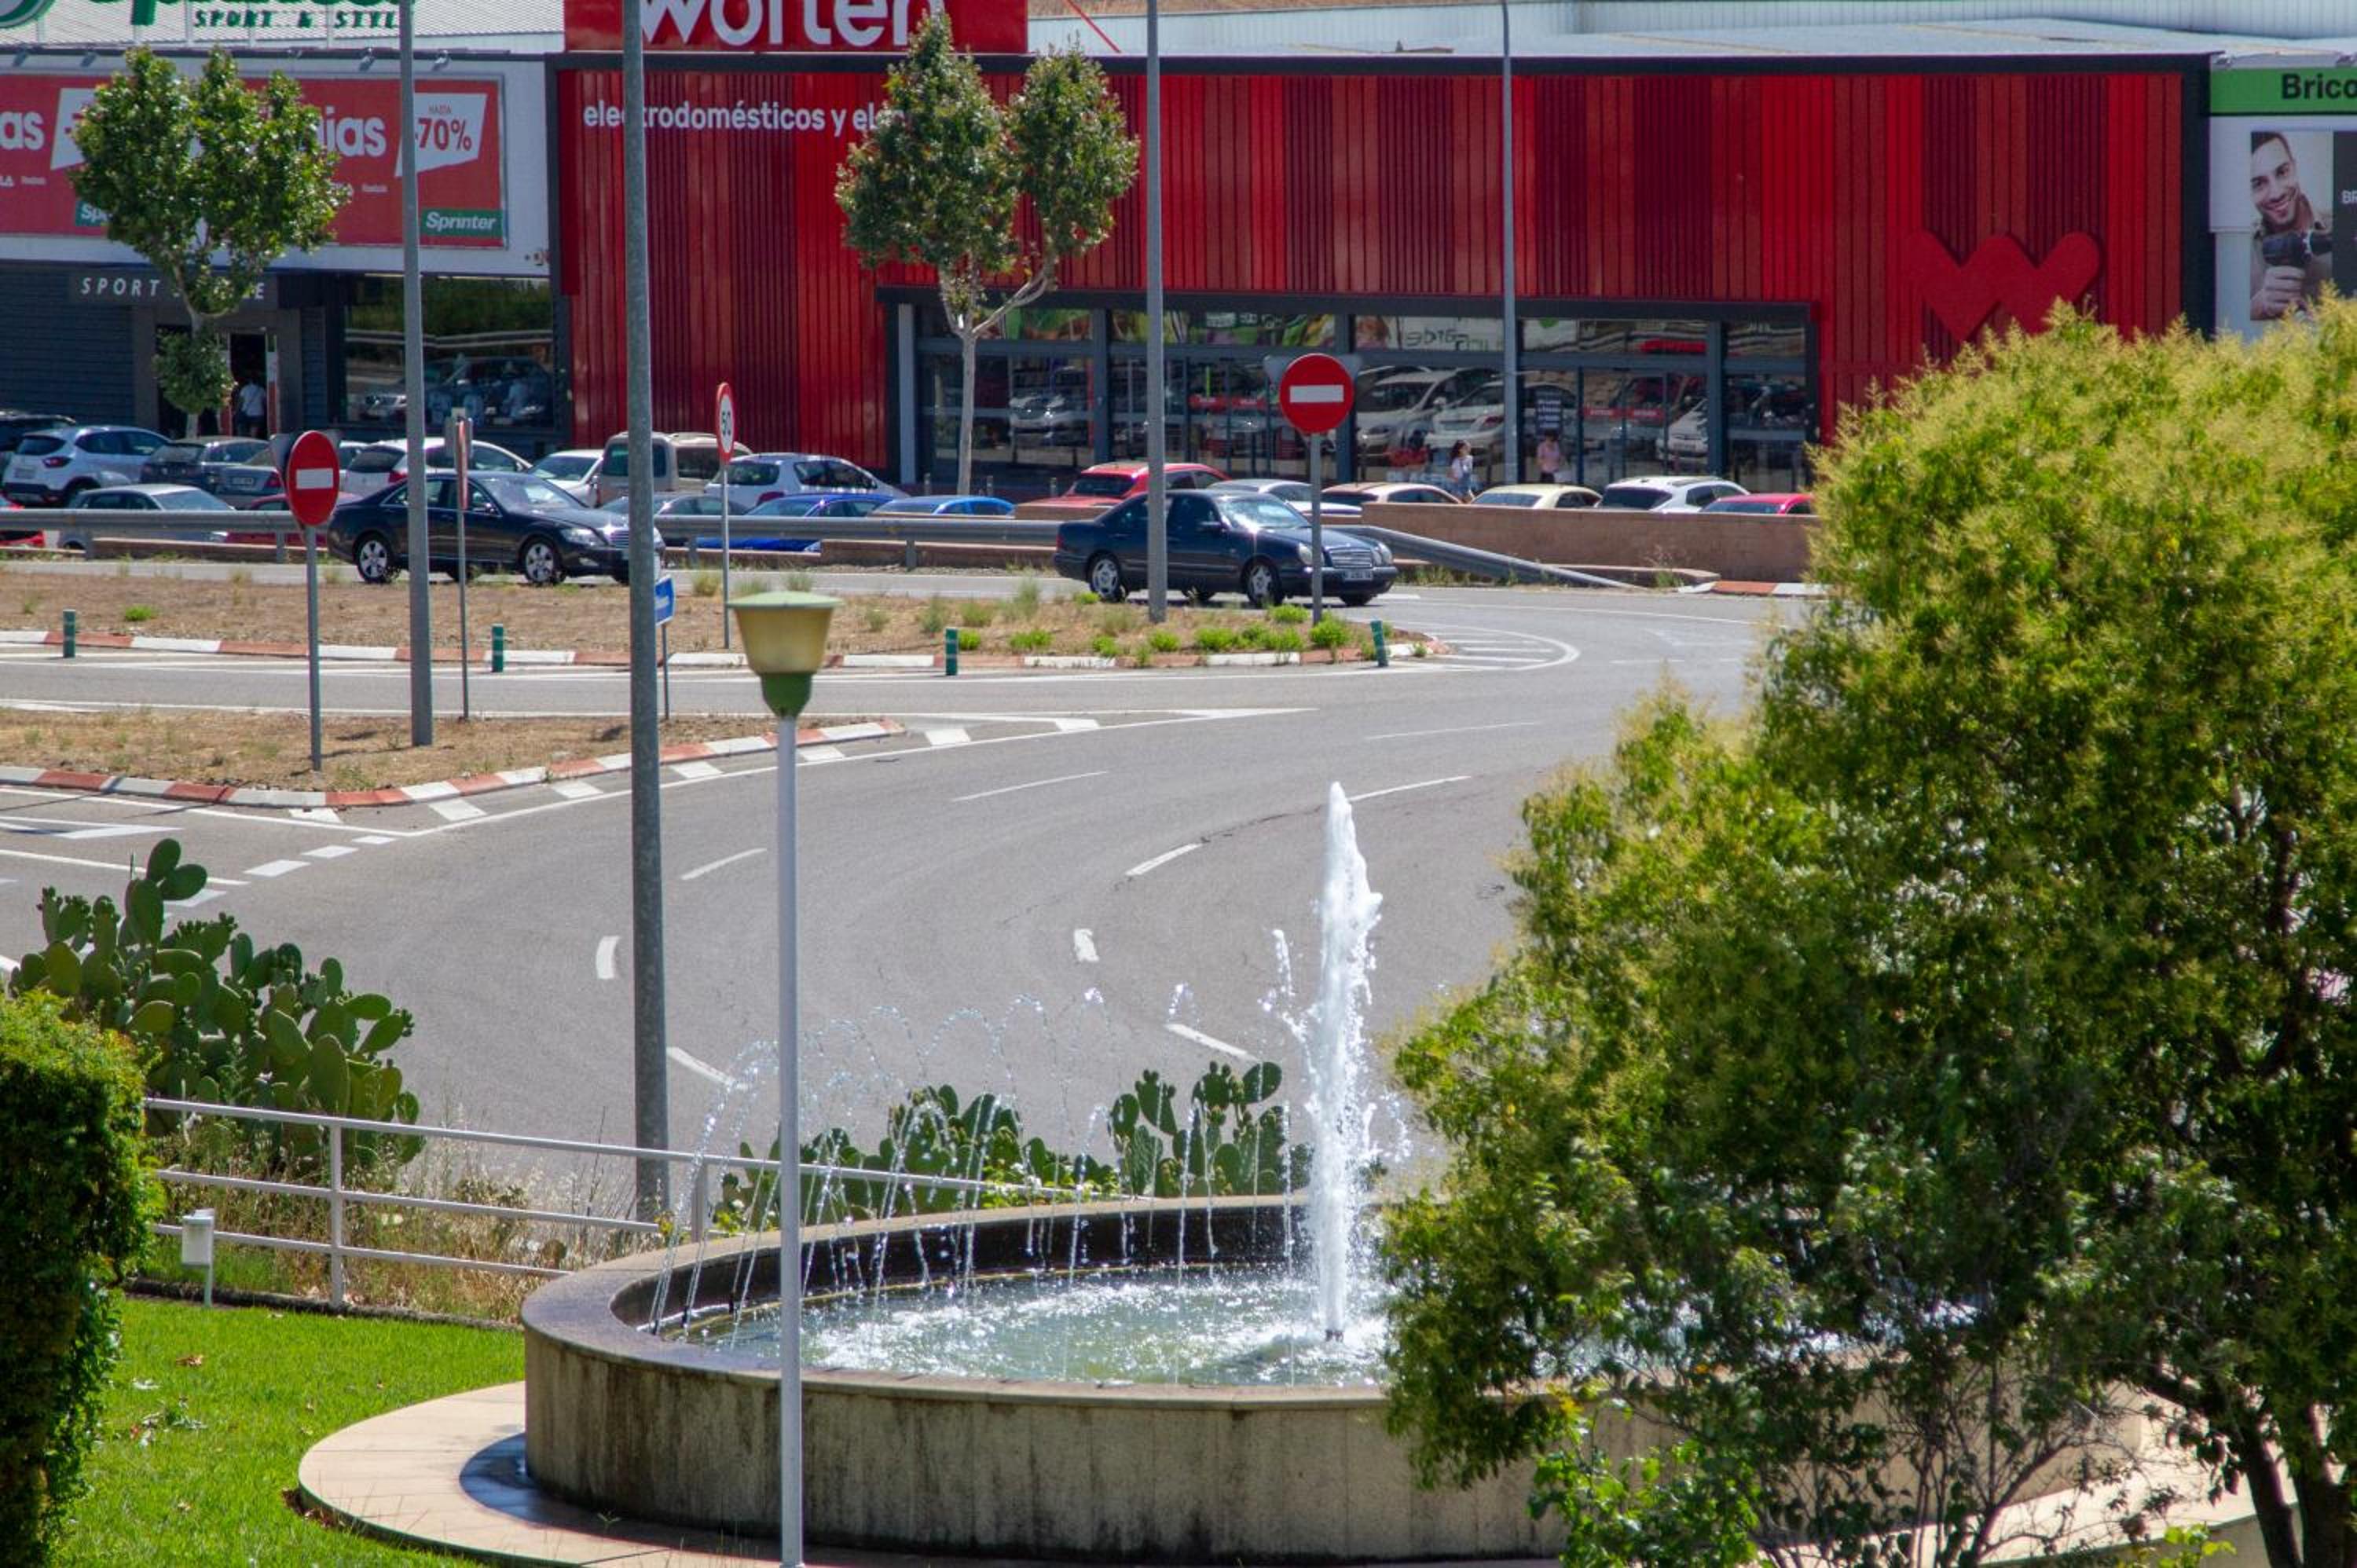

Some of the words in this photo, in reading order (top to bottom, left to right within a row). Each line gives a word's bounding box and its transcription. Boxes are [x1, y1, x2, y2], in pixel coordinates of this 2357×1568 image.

[194, 10, 272, 27] SPORT
[334, 10, 399, 28] STYL
[2282, 72, 2357, 100] Brico
[584, 100, 825, 131] elerodomésticos
[830, 108, 847, 137] y
[426, 211, 497, 232] Sprinter
[80, 277, 160, 297] SPORT
